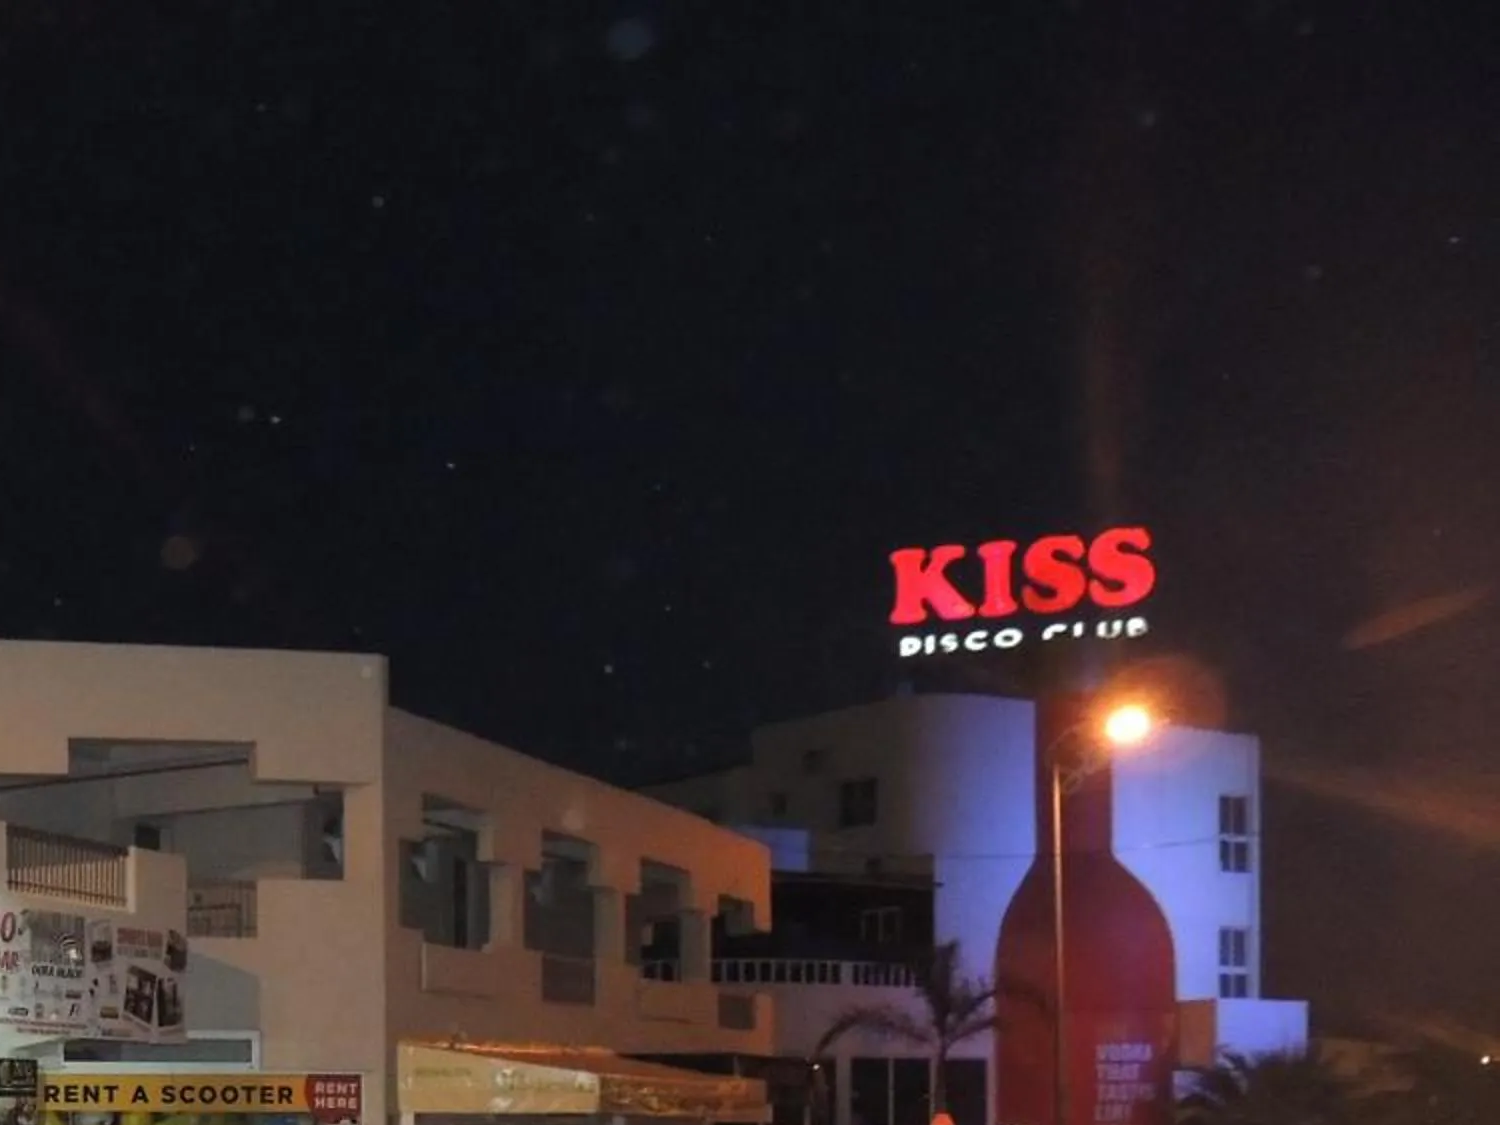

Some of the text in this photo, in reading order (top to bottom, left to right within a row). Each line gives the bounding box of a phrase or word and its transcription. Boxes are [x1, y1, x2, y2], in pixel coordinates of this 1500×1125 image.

[889, 527, 1155, 625] KISS
[899, 628, 1024, 657] DISCO
[43, 1085, 294, 1105] RENT A SCOOTER
[314, 1080, 358, 1095] RENT
[314, 1096, 358, 1110] HERE
